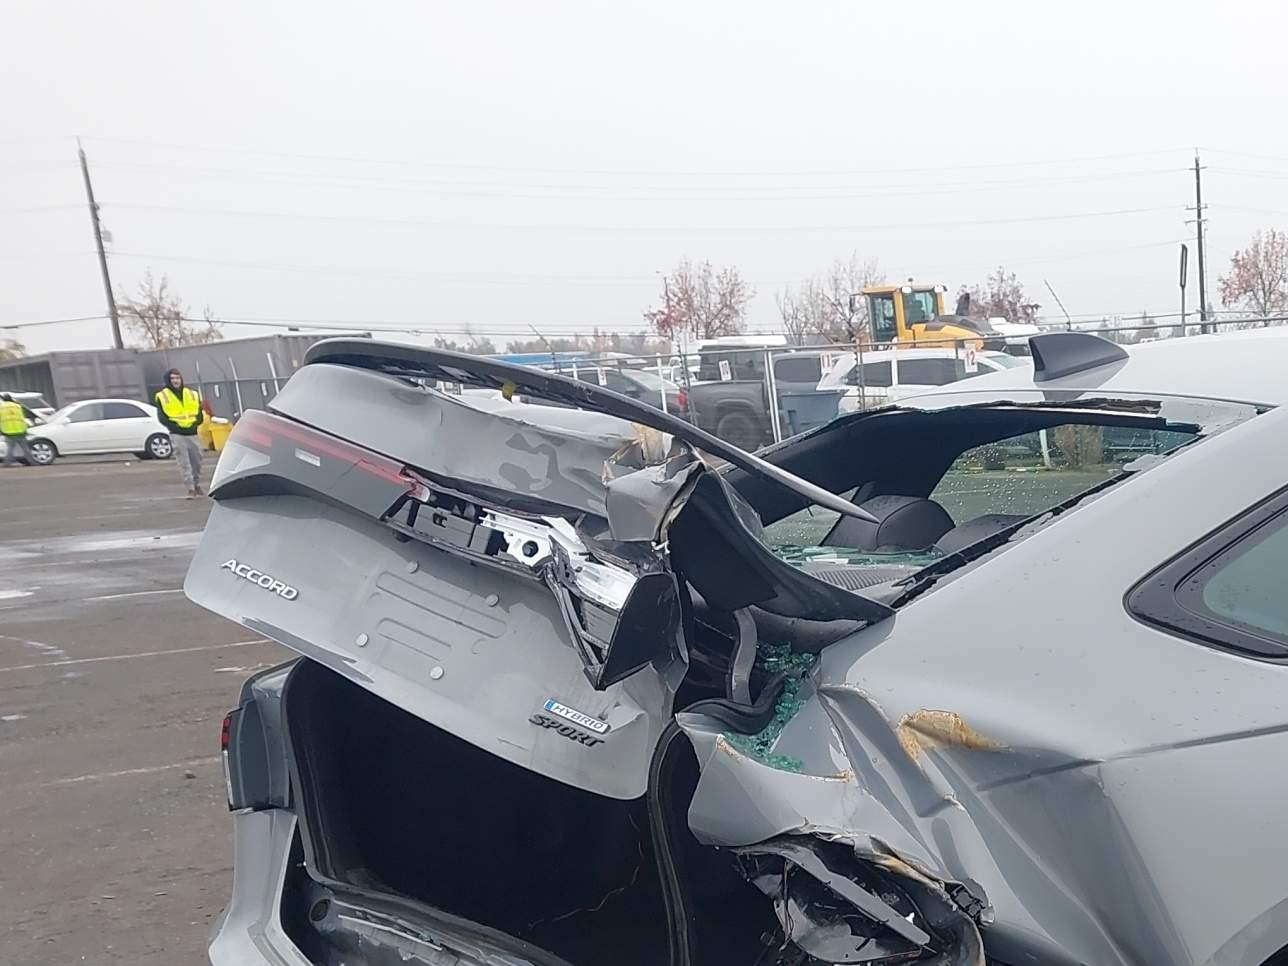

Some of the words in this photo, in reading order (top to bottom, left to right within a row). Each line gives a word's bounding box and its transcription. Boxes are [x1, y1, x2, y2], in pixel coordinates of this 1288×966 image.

[221, 559, 299, 601] ACCORD
[528, 714, 605, 747] SPORT
[553, 704, 604, 730] HYBRID
